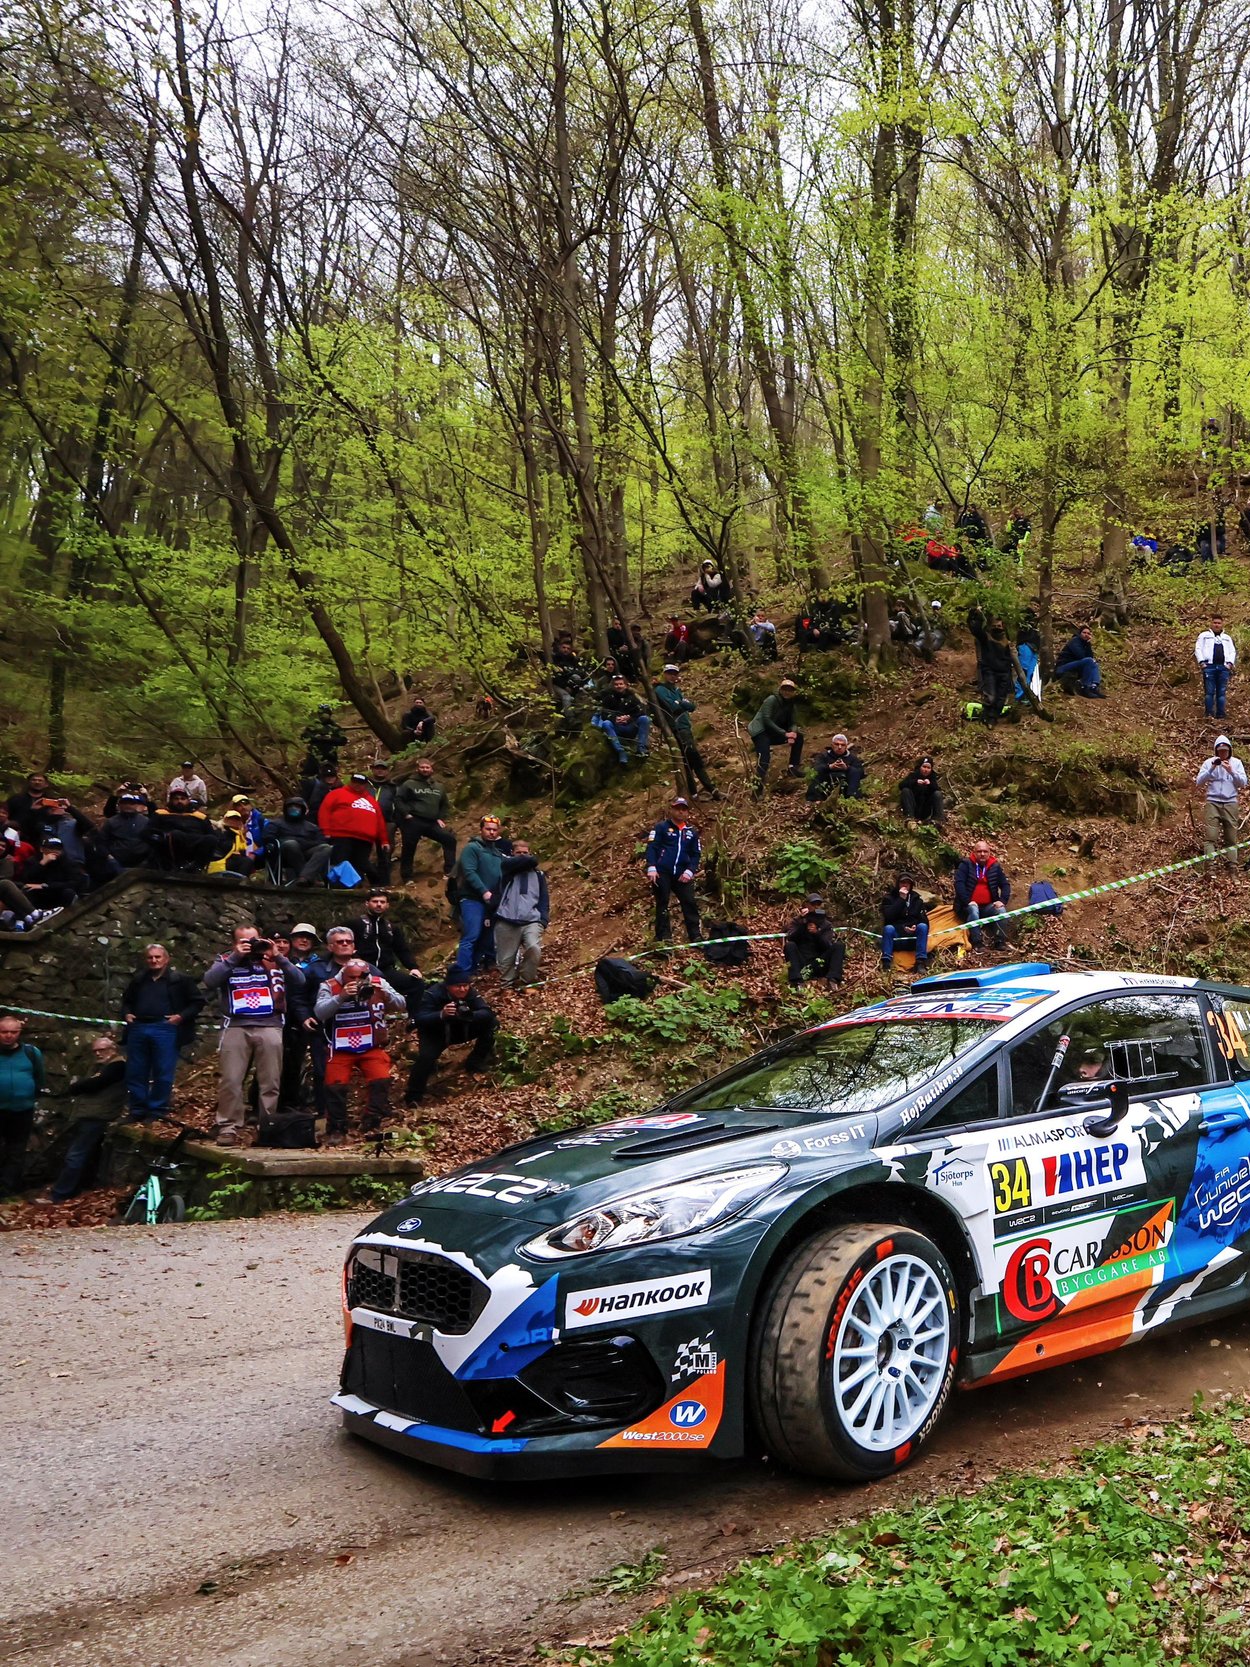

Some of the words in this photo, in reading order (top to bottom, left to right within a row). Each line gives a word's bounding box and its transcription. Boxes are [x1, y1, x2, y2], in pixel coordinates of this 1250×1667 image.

[371, 1002, 386, 1030] 245
[1232, 1010, 1248, 1031] M
[1206, 1010, 1249, 1060] 34
[804, 1132, 850, 1151] Forss
[850, 1124, 865, 1140] IT
[940, 1169, 974, 1182] Sjötorps
[1074, 1143, 1129, 1190] HEP
[1215, 1166, 1231, 1181] FIA
[991, 1159, 1031, 1212] 34
[1200, 1166, 1250, 1206] JUNIOR
[1009, 1214, 1036, 1228] WRC2
[1053, 1222, 1168, 1276] CARSON
[1060, 1258, 1138, 1294] BYGGARE
[1149, 1250, 1167, 1263] AB
[598, 1280, 705, 1314] HANKOOK
[694, 1353, 710, 1369] M
[675, 1404, 707, 1423] W
[622, 1431, 705, 1442] West2000.se
